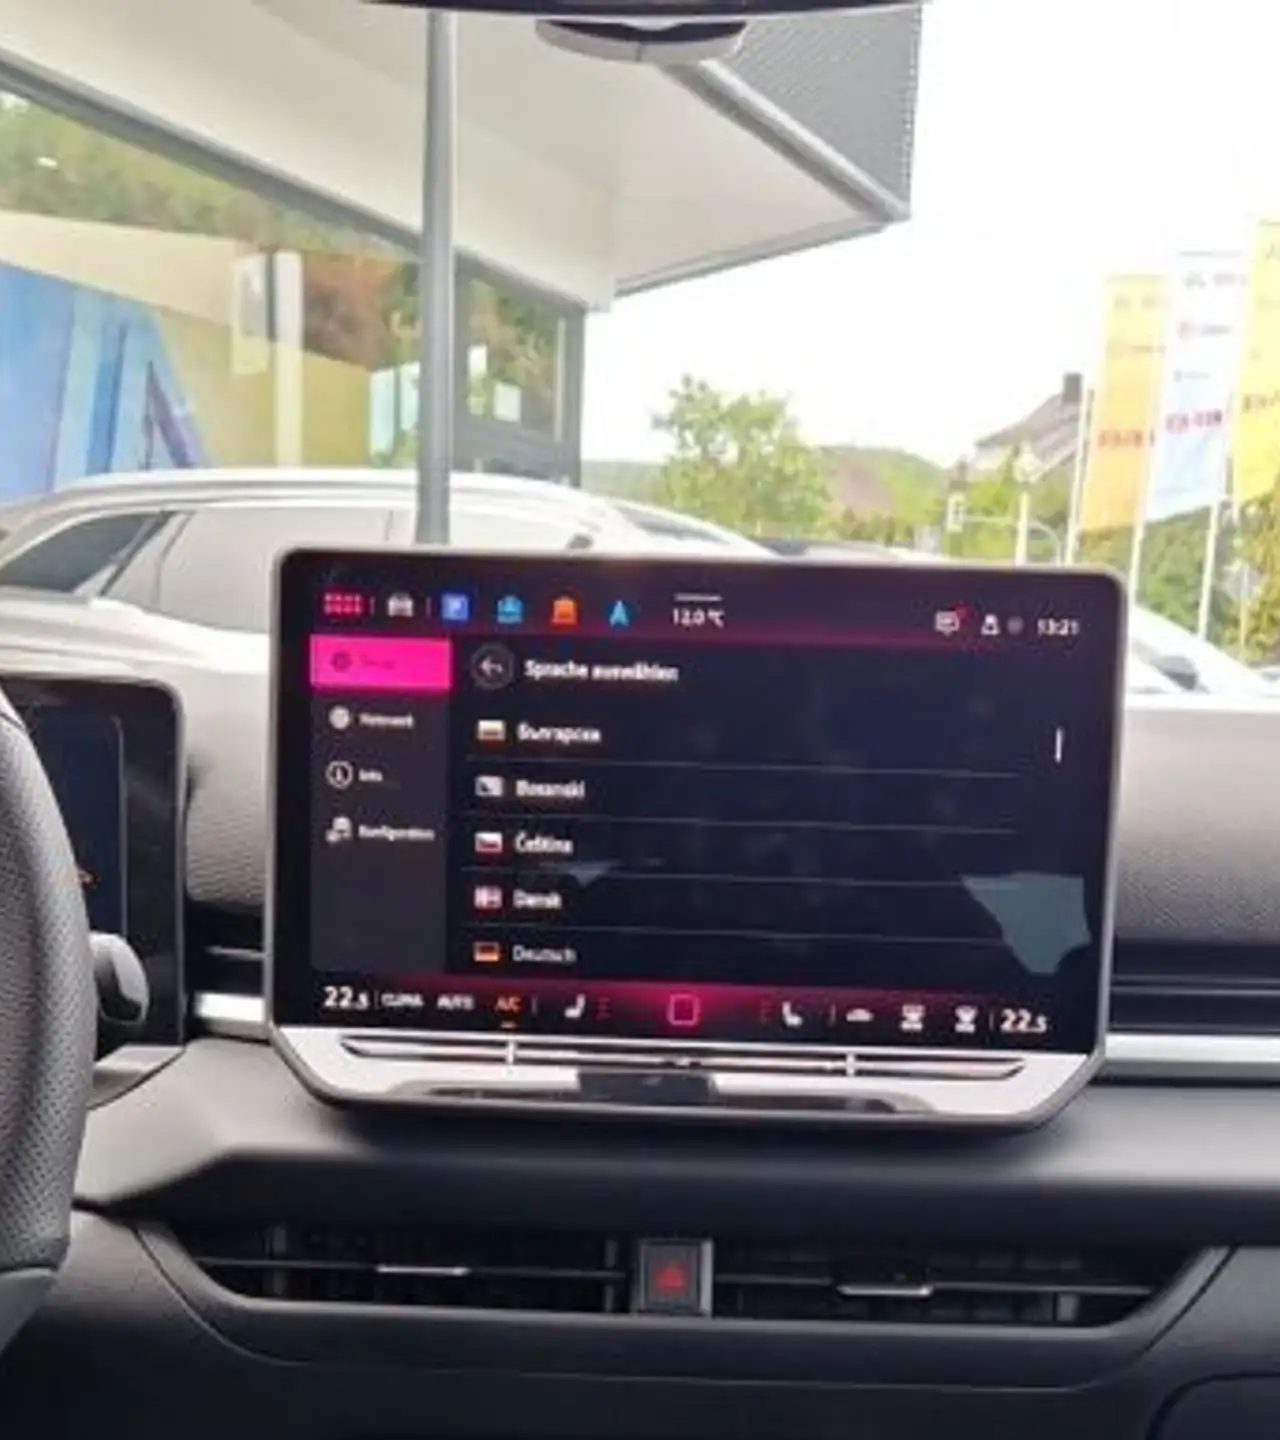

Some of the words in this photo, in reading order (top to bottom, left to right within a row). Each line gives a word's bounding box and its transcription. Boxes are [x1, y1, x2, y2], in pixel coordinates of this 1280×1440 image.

[524, 659, 588, 681] Sprache
[591, 662, 679, 682] auswählen
[516, 779, 585, 799] Bosanski
[513, 887, 563, 910] Dansk
[512, 944, 578, 964] Deutsch
